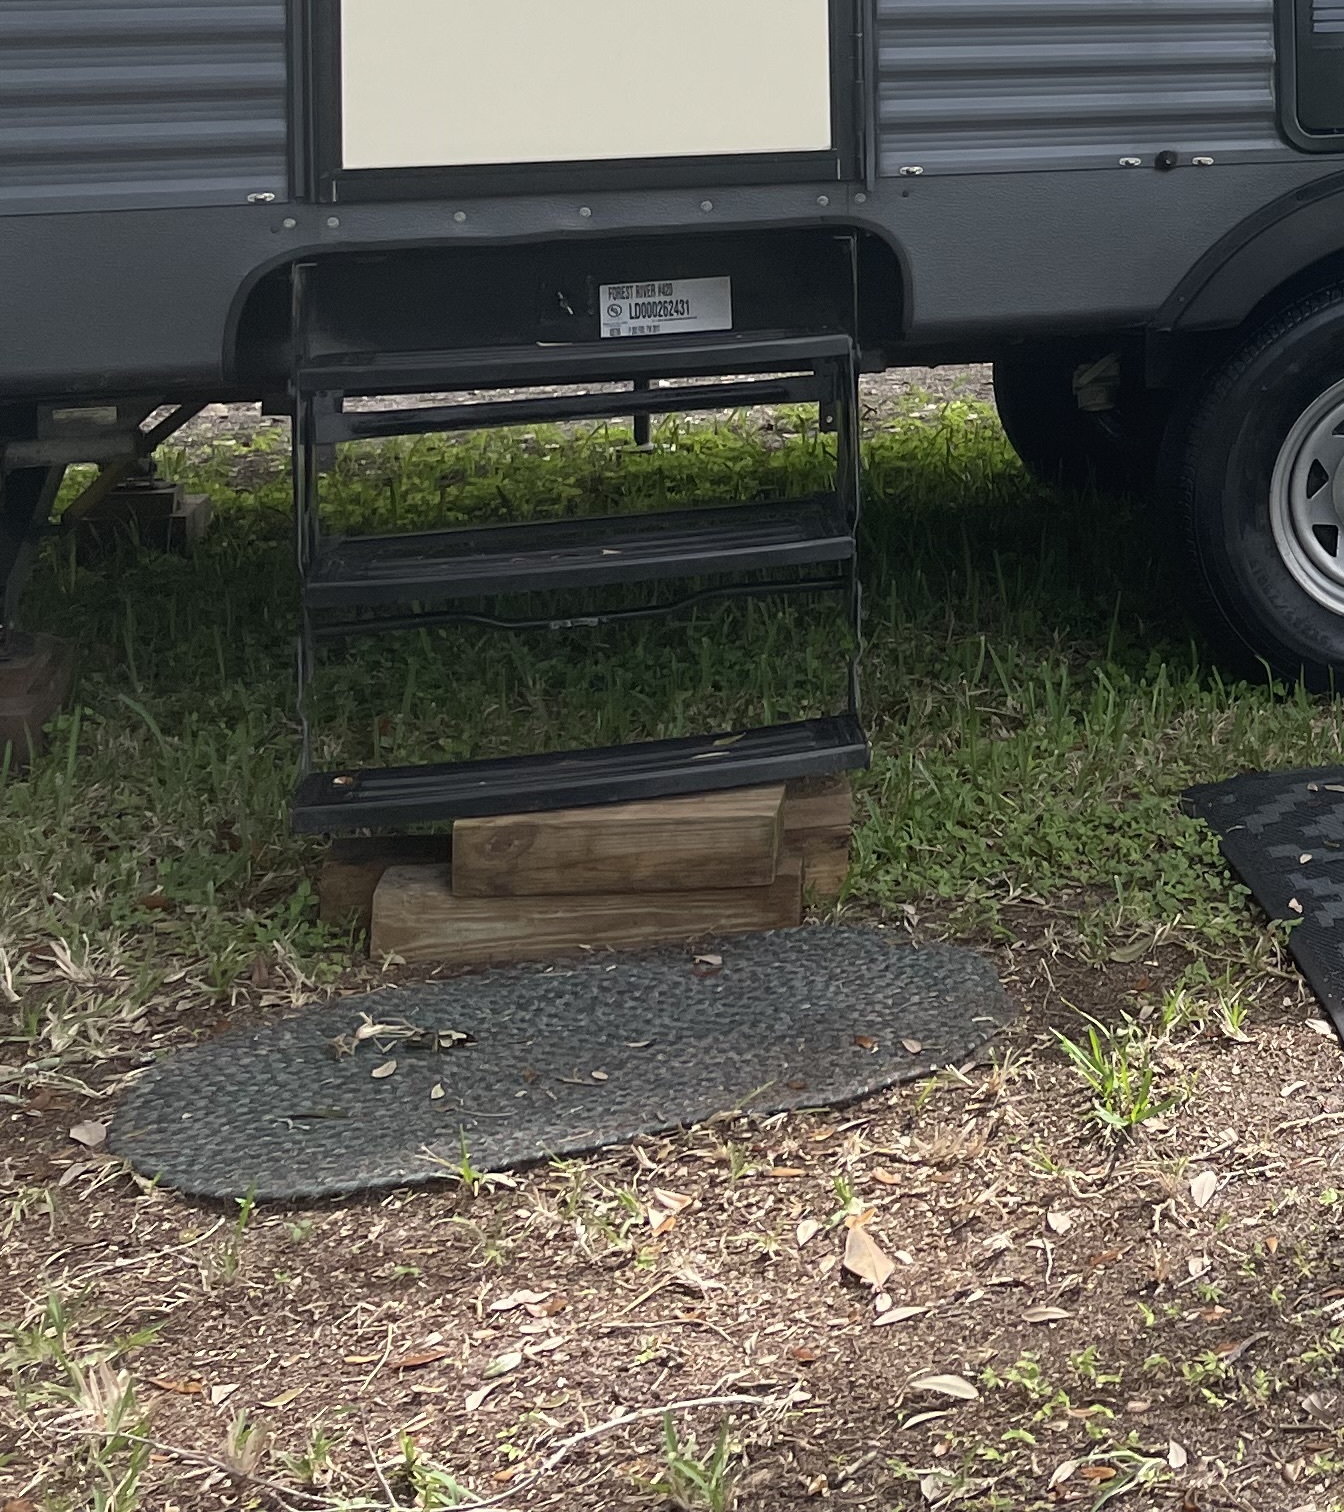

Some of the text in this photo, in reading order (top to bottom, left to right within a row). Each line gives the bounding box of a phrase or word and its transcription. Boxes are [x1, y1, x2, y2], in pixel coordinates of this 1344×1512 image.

[608, 285, 634, 300] FOREST
[635, 283, 656, 298] RIVER
[628, 299, 690, 320] LD000262431
